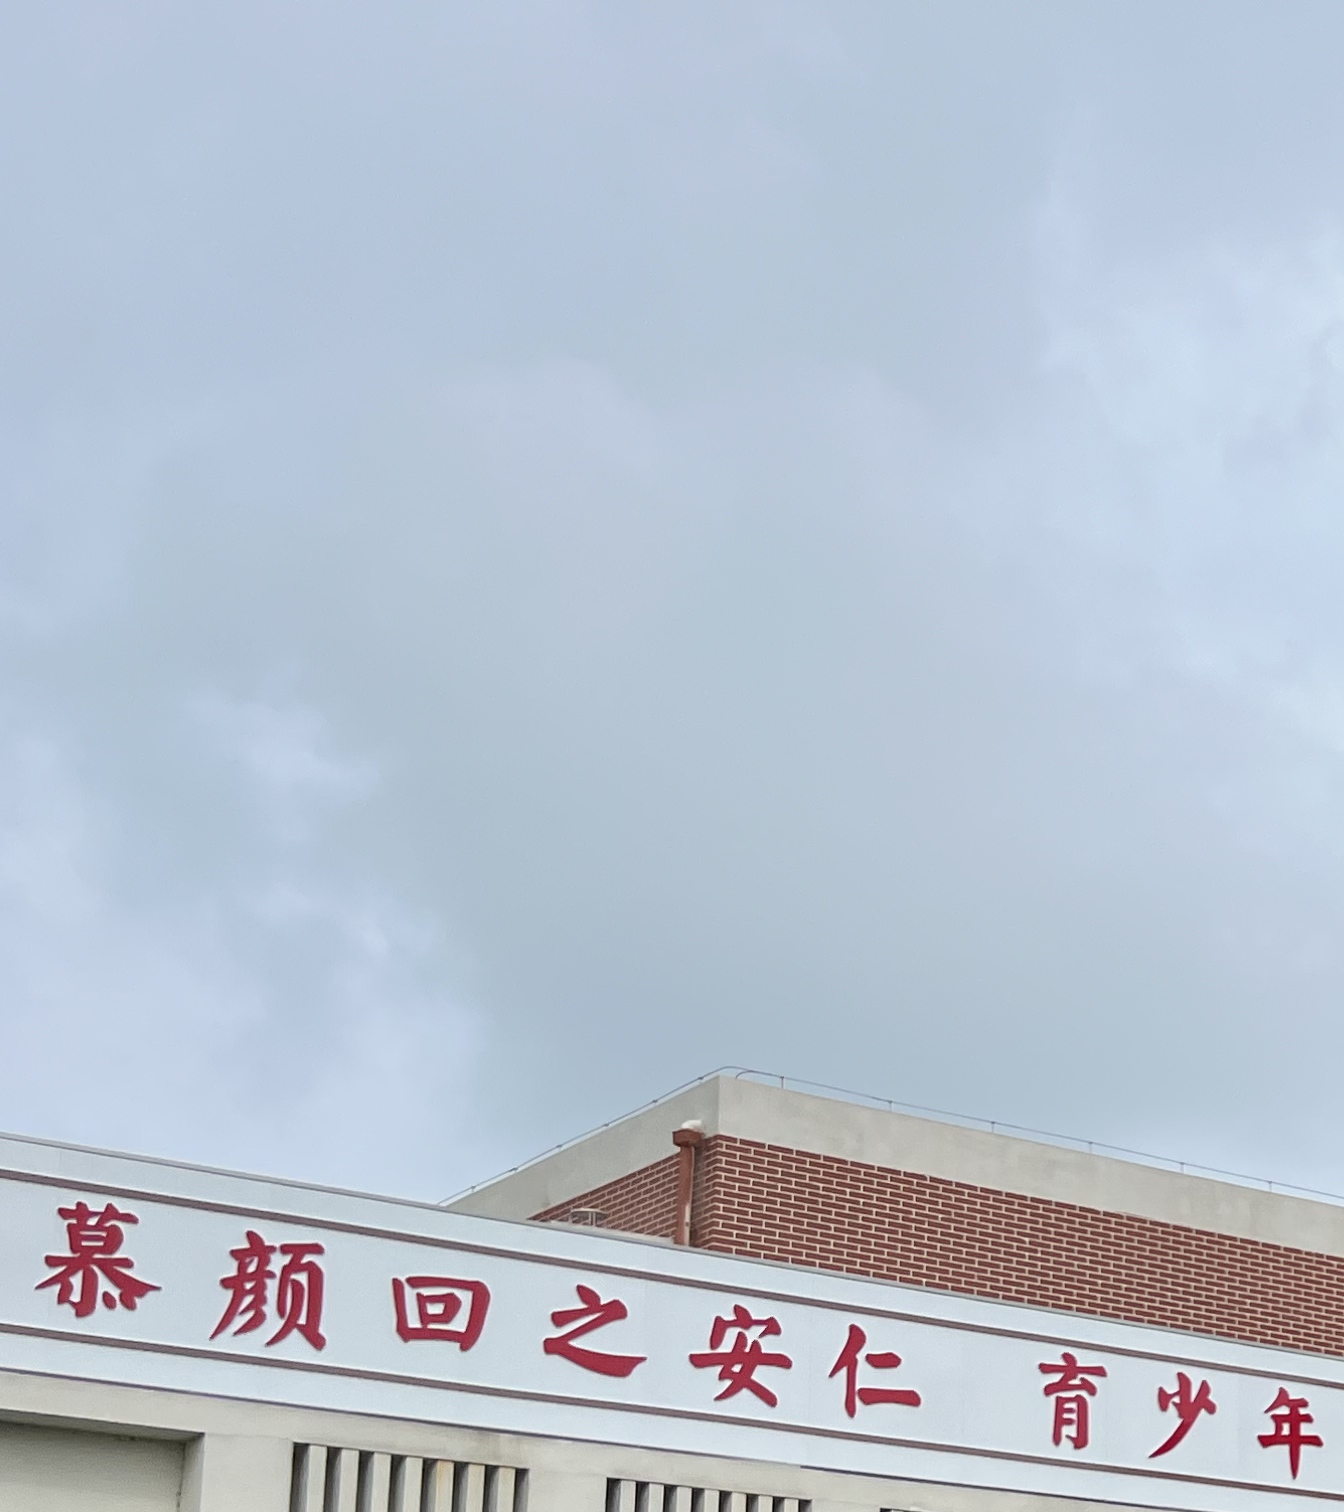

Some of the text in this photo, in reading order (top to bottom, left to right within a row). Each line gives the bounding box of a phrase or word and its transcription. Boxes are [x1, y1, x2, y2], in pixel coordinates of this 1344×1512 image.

[35, 1199, 922, 1417] 慕颜回之安仁
